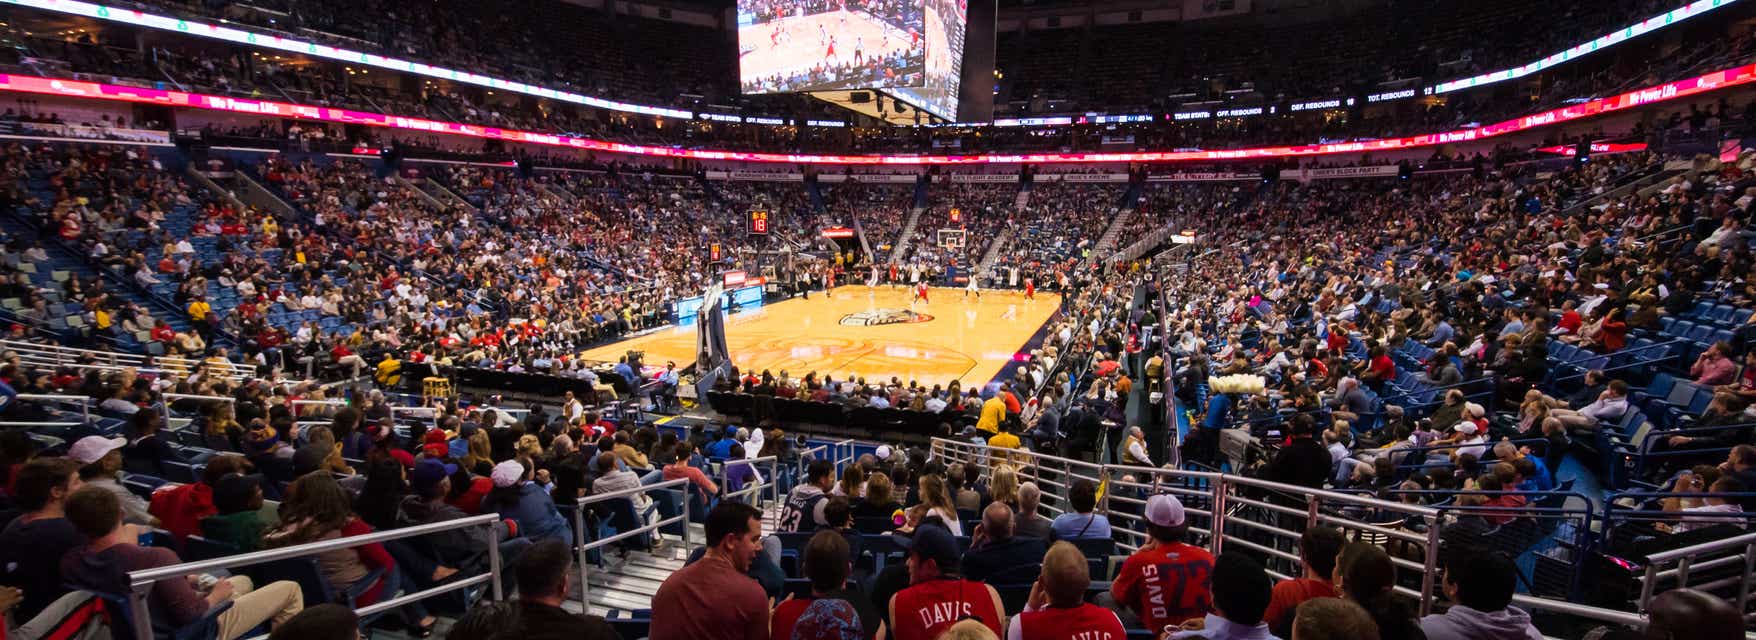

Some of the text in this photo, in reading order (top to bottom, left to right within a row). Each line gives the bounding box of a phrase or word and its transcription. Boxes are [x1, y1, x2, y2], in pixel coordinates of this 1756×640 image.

[1381, 89, 1415, 100] REBOUNDS
[1630, 84, 1677, 104] We Power Life
[209, 96, 279, 113] We Power Life
[1305, 100, 1340, 109] REBOUNDS
[1230, 108, 1262, 116] REBOUNDS
[408, 118, 430, 130] Power
[755, 219, 765, 231] 18
[780, 506, 802, 533] 23
[1142, 563, 1168, 618] DAVIS
[919, 601, 971, 629] DAVIS
